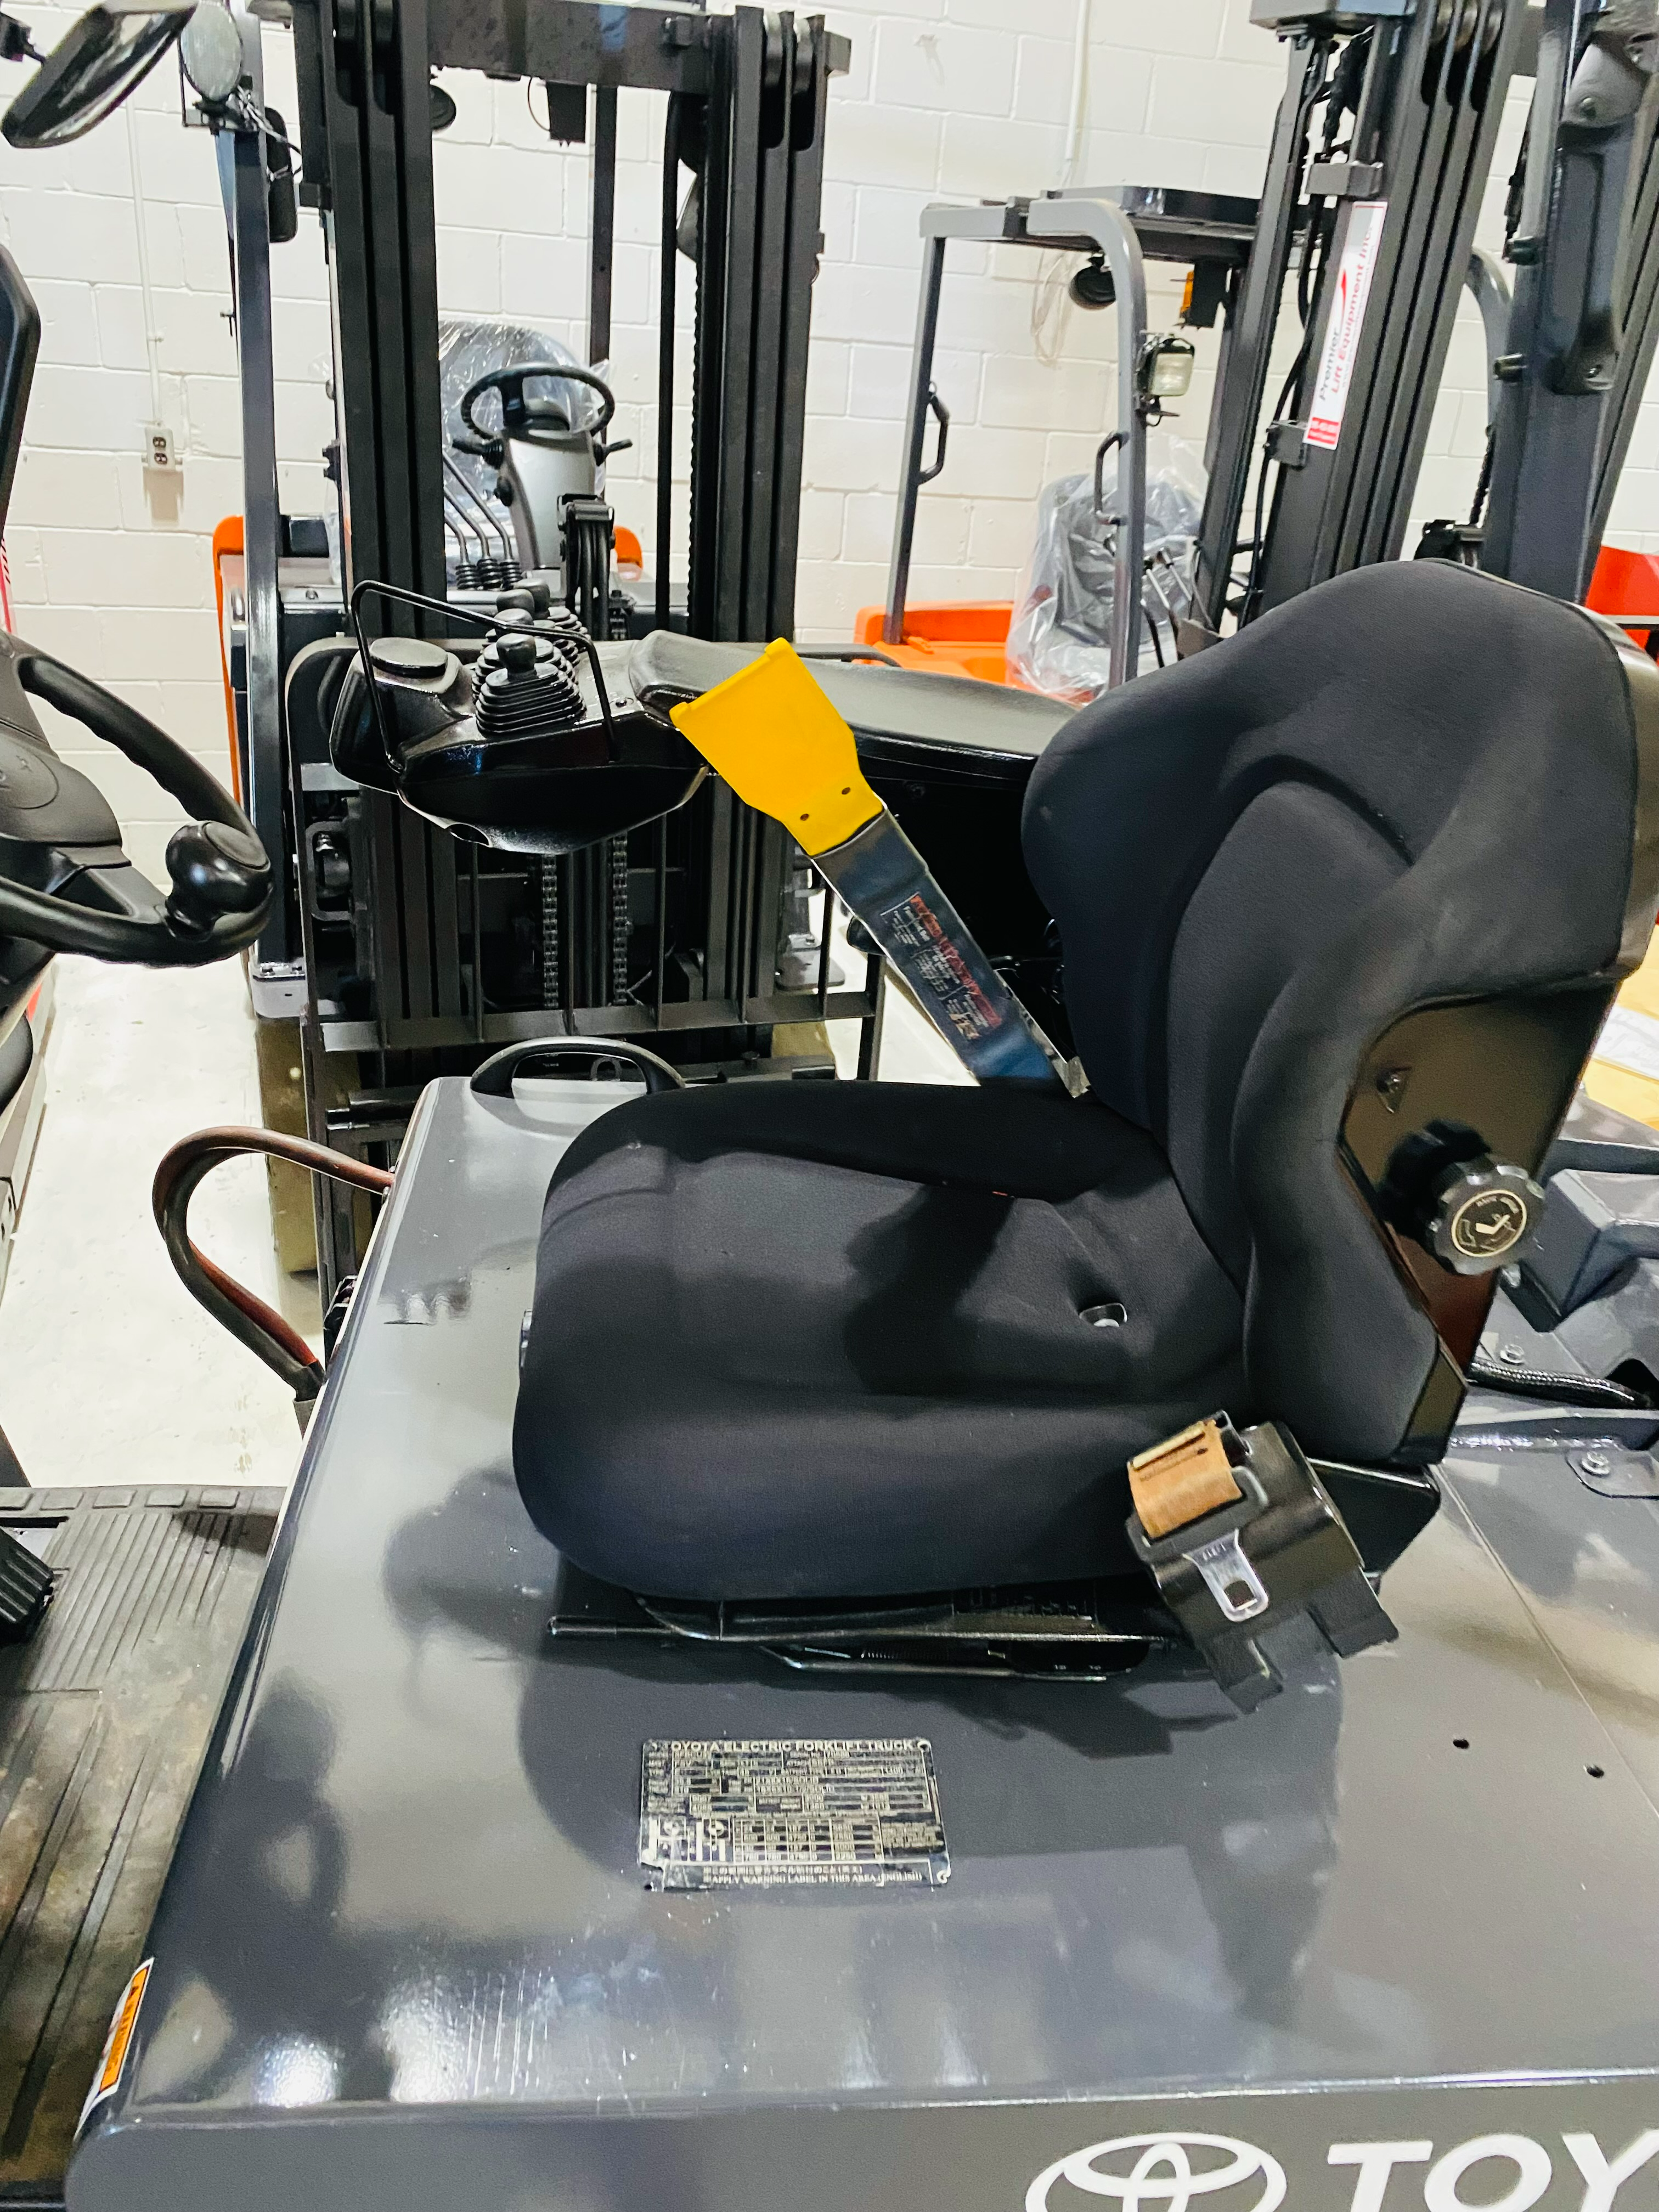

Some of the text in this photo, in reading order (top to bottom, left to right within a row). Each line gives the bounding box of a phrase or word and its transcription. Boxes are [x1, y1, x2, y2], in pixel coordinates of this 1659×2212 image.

[1331, 366, 1342, 393] Lift
[1338, 264, 1363, 360] Equipment
[1319, 328, 1339, 401] Premier
[724, 1740, 792, 1752] ELECTRIC
[795, 1740, 862, 1752] FORKLIFT
[866, 1740, 914, 1751] TRUCK
[713, 1871, 923, 1883] APPLY WARNING LABEL IN THIS AREA (NGLISH)
